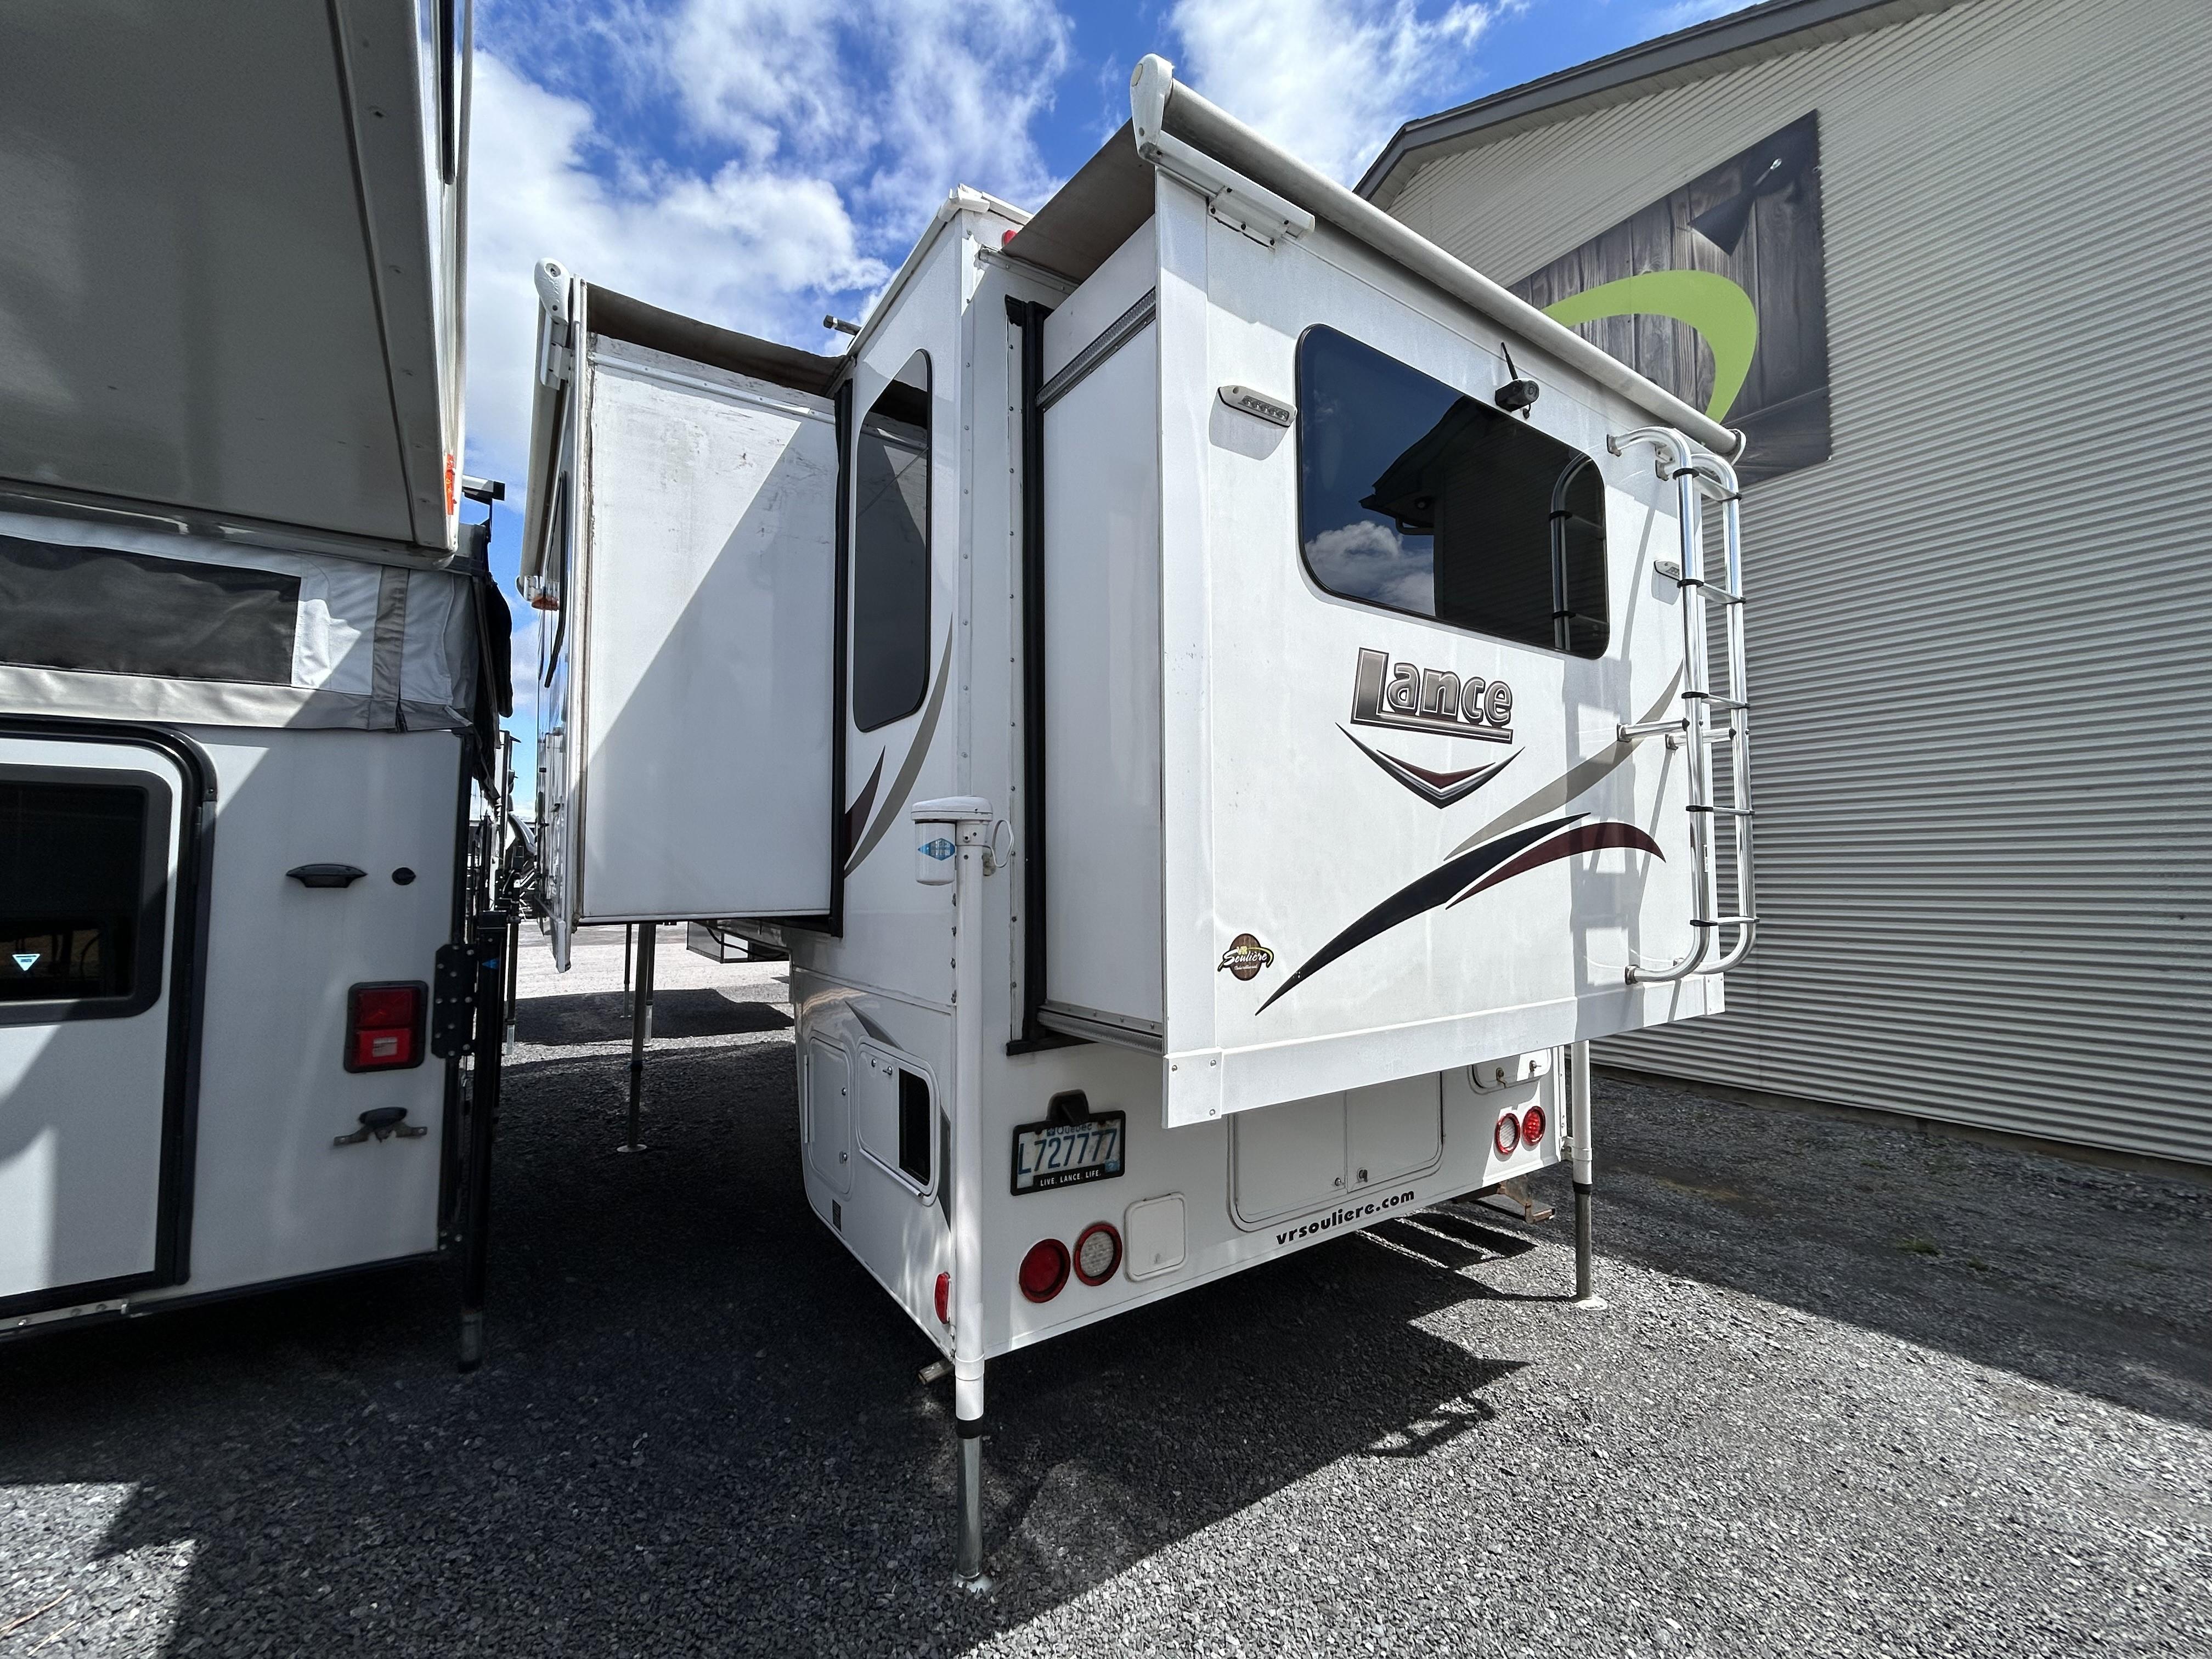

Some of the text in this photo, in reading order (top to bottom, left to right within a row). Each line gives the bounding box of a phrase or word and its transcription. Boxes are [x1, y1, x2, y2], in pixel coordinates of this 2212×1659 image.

[1350, 647, 1513, 744] Lance
[1236, 945, 1248, 955] VR
[1018, 1128, 1118, 1175] L727777
[1276, 1190, 1414, 1245] vrsouliere.com
